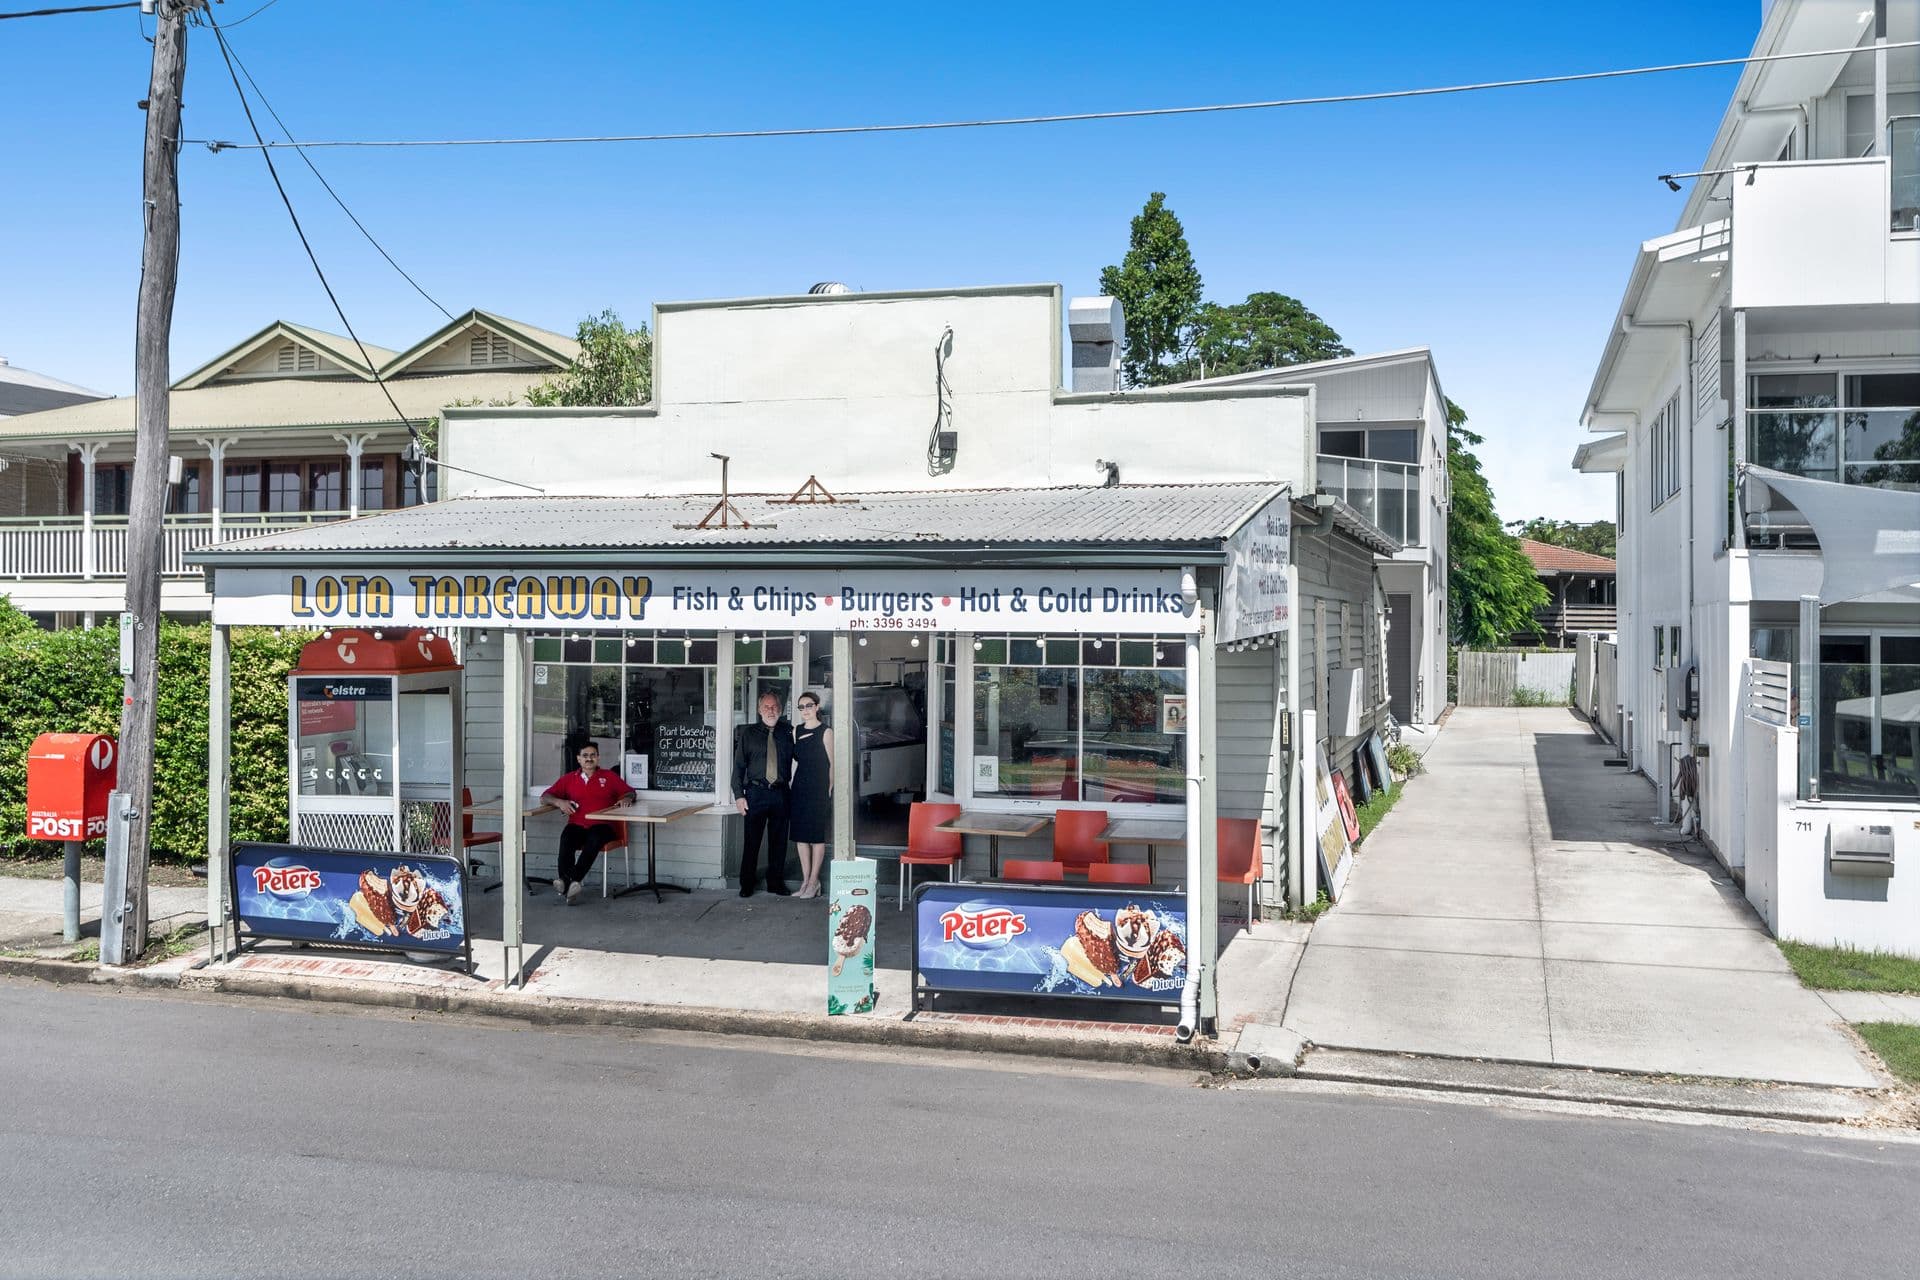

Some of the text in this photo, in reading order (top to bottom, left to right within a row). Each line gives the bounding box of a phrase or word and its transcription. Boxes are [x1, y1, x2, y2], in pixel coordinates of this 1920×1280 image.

[291, 576, 652, 619] LOTA TAKEAWAY
[673, 586, 1183, 617] Fish & Chips Burgers Hot & Cold Drinks
[850, 618, 937, 629] ph: 3396 3494
[323, 685, 366, 699] Telstra
[659, 725, 677, 736] Plant
[679, 725, 705, 737] Based
[659, 738, 706, 750] GF CHICKEN
[669, 751, 680, 760] your
[31, 817, 83, 837] POST
[1795, 821, 1812, 832] 711
[254, 866, 320, 893] Peters
[940, 910, 1025, 942] Peters
[1152, 977, 1175, 991] Dive
